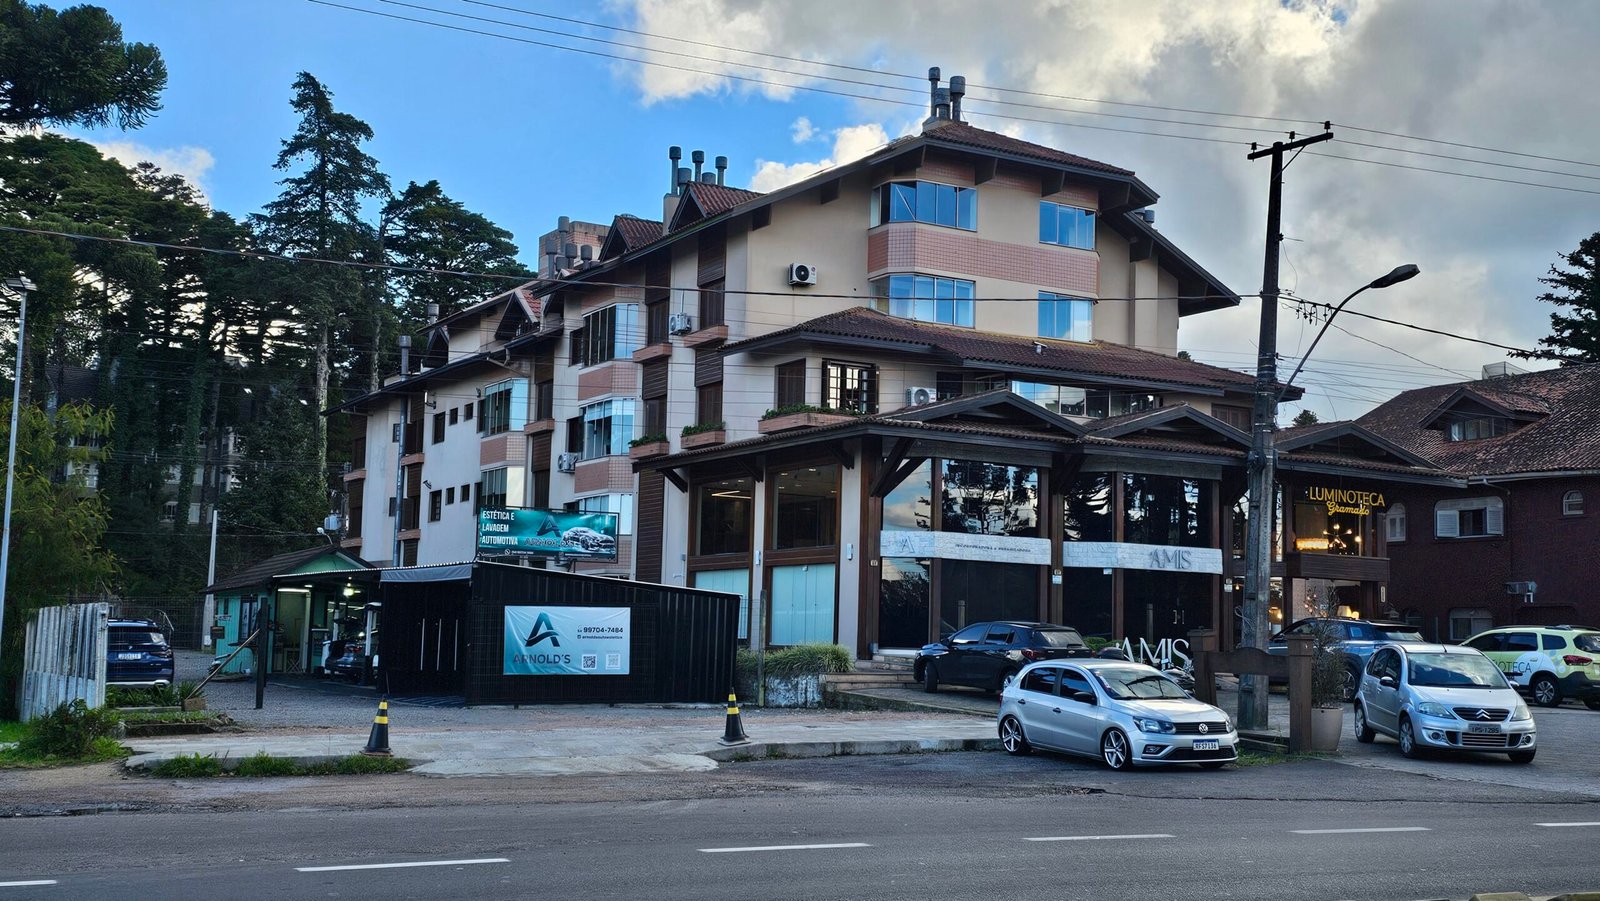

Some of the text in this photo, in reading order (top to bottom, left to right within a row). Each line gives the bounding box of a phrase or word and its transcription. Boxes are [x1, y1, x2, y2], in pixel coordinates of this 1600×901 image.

[1309, 486, 1385, 507] LUMINOTECA
[482, 510, 515, 521] ESTÉTICA E
[1326, 501, 1370, 516] Gramado
[482, 523, 509, 533] LAVAGEM
[481, 535, 519, 546] AUTOMOTIVA
[1149, 548, 1192, 570] AMIS
[1116, 636, 1194, 671] AMIS
